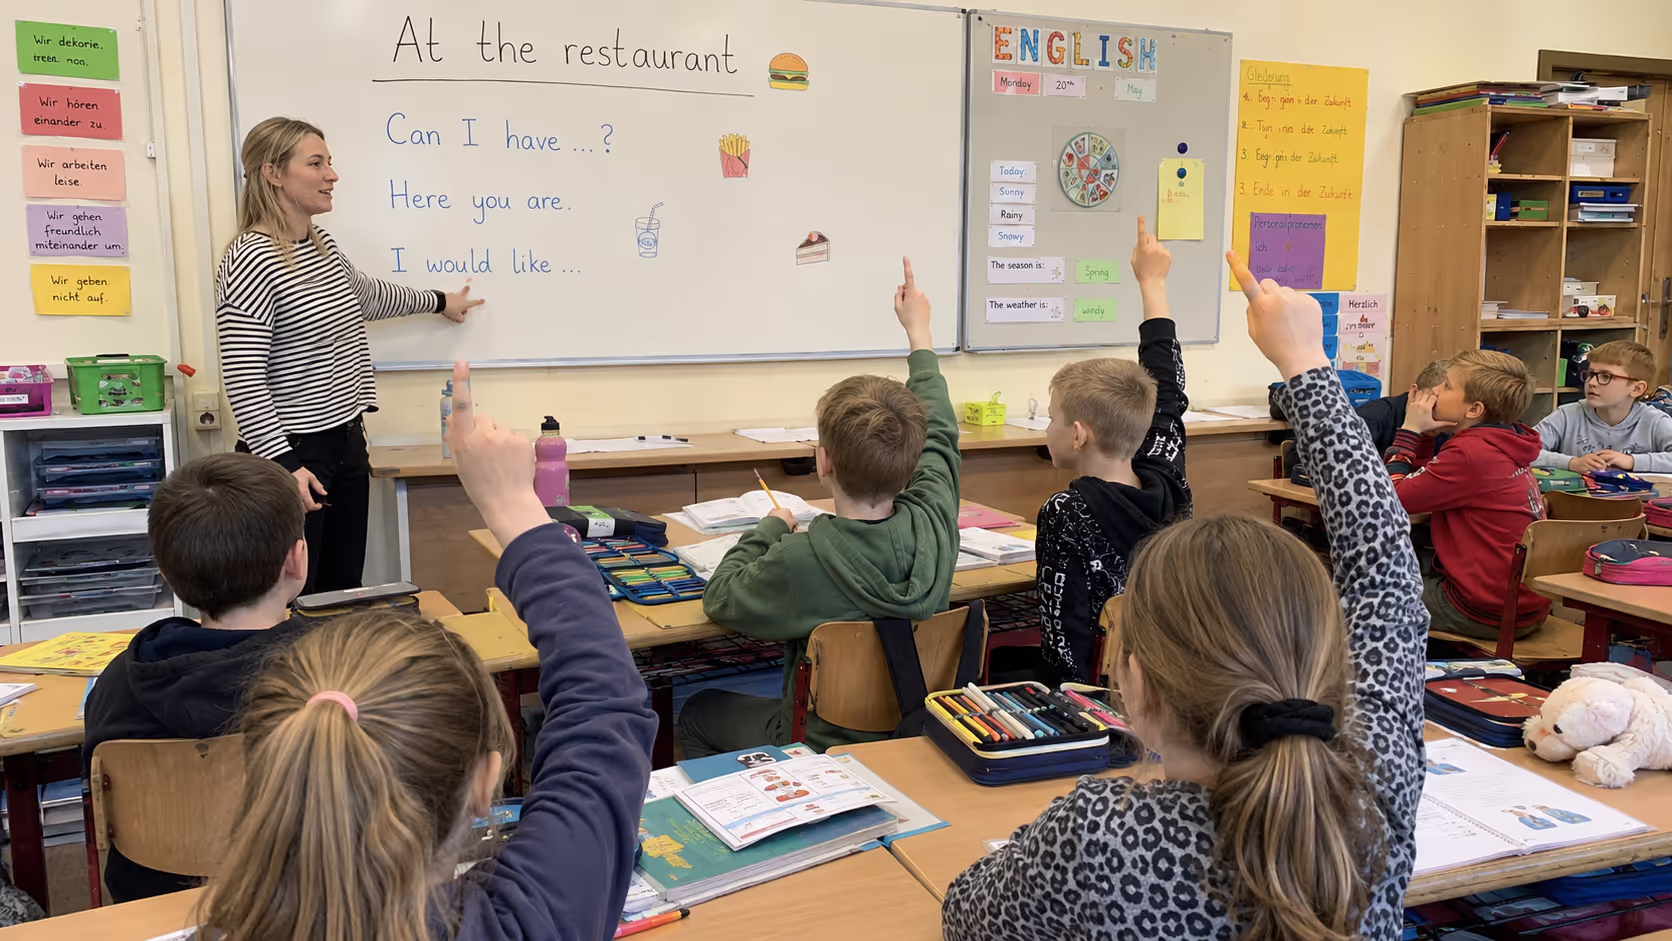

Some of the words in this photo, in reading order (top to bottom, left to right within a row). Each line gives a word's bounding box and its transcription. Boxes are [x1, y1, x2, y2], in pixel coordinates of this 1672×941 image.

[33, 34, 52, 45] Wir
[392, 15, 443, 63] At
[476, 20, 538, 64] the
[564, 27, 738, 74] restaurant
[994, 26, 1157, 70] ENGLISH
[1000, 76, 1033, 91] Monday
[1126, 83, 1143, 99] May
[38, 96, 58, 107] Wir
[34, 115, 81, 127] einander
[90, 121, 106, 130] zu.
[386, 112, 441, 146] Can
[461, 118, 479, 147] I
[505, 119, 561, 152] have
[37, 158, 56, 169] Wir
[62, 159, 108, 171] arbeiten
[999, 165, 1027, 178] Today:
[54, 174, 83, 187] leise.
[999, 187, 1025, 199] Sunny
[1253, 182, 1274, 197] Ende
[390, 178, 451, 210] Here
[472, 194, 512, 225] you
[527, 195, 572, 211] are.
[46, 211, 65, 220] Wir
[72, 211, 103, 226] gehen
[1000, 210, 1023, 221] Rainy
[44, 225, 102, 237] freundlich
[998, 231, 1025, 243] Snowy
[35, 239, 99, 251] miteinander
[391, 247, 407, 274] I
[426, 248, 492, 274] would
[512, 248, 552, 274] like
[990, 261, 1006, 270] The
[1008, 262, 1034, 270] season
[1035, 261, 1045, 270] is:
[1085, 265, 1110, 281] Spring
[50, 275, 69, 285] Wir
[52, 292, 81, 302] nicht
[87, 293, 108, 304] auf.
[989, 300, 1004, 309] The
[1005, 300, 1037, 309] weather
[1039, 301, 1049, 309] is:
[1348, 299, 1379, 309] Herzlich
[1081, 306, 1105, 319] windy
